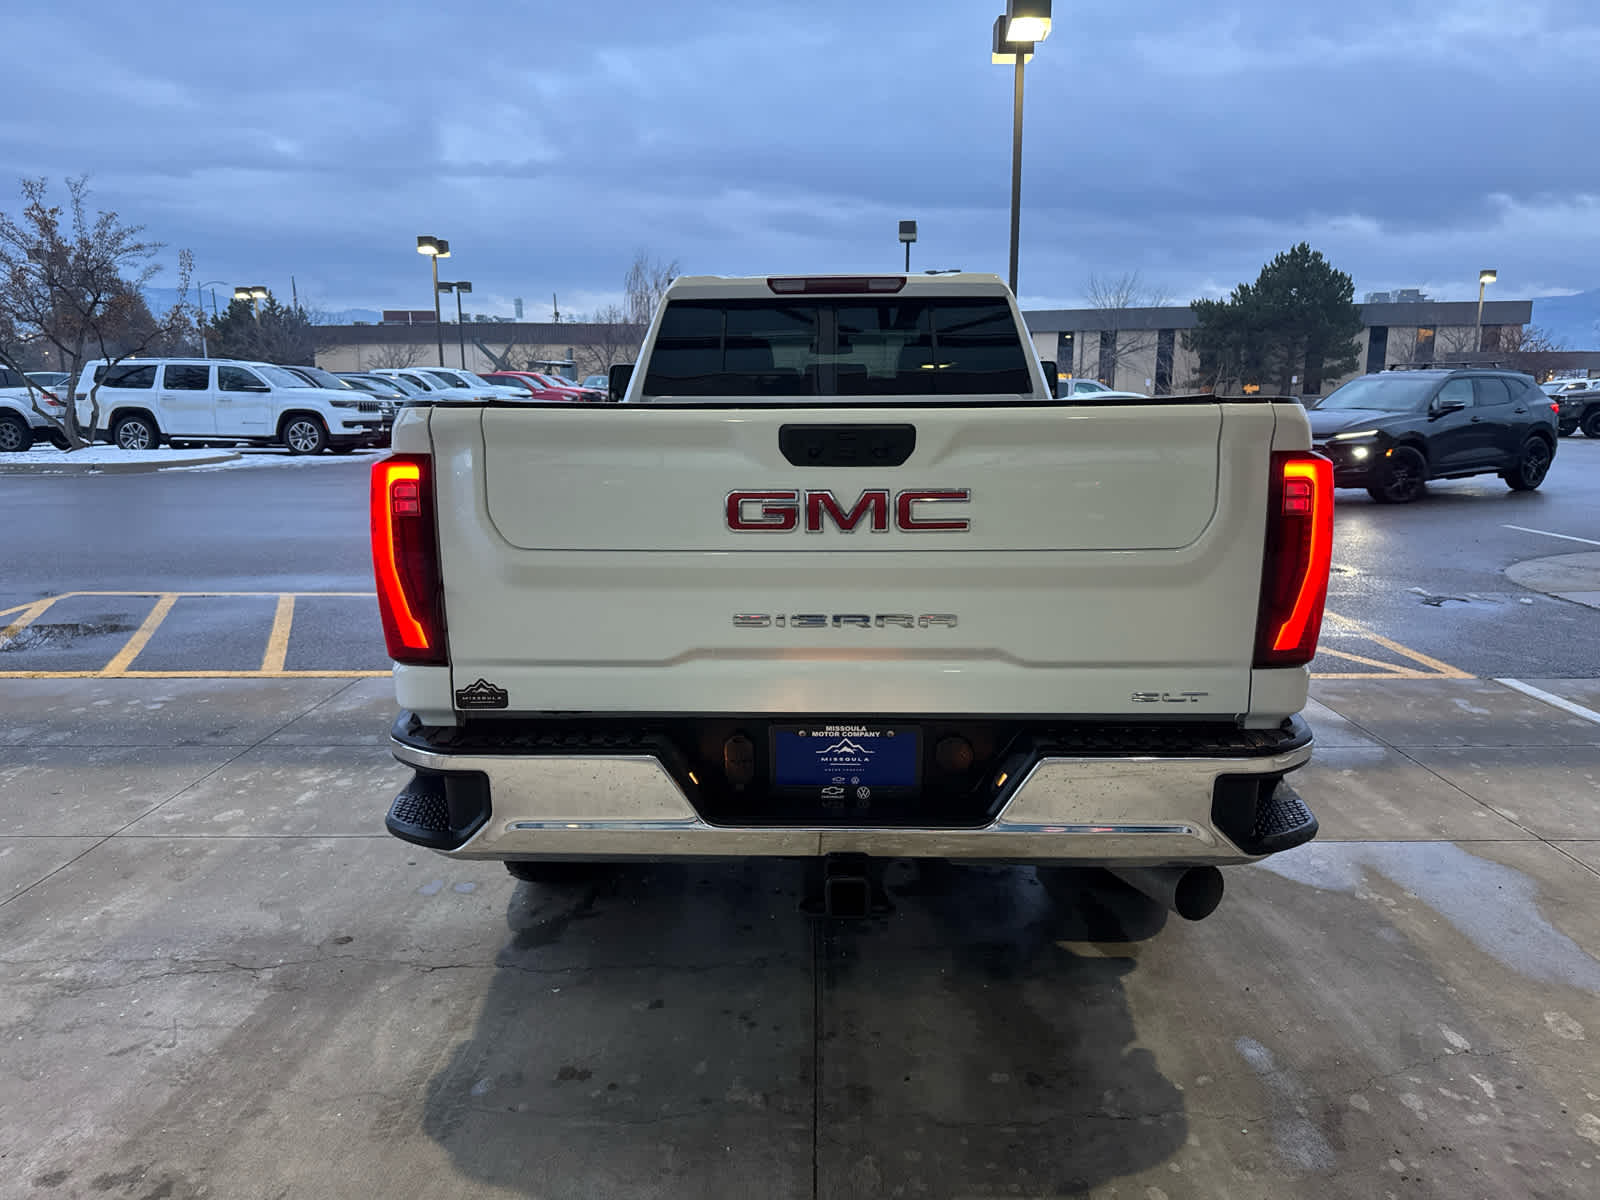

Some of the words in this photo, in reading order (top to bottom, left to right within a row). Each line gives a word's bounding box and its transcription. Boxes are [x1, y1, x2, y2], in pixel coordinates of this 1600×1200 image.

[725, 488, 971, 534] GMC
[732, 614, 959, 628] SIERRA
[1130, 691, 1209, 702] SLT
